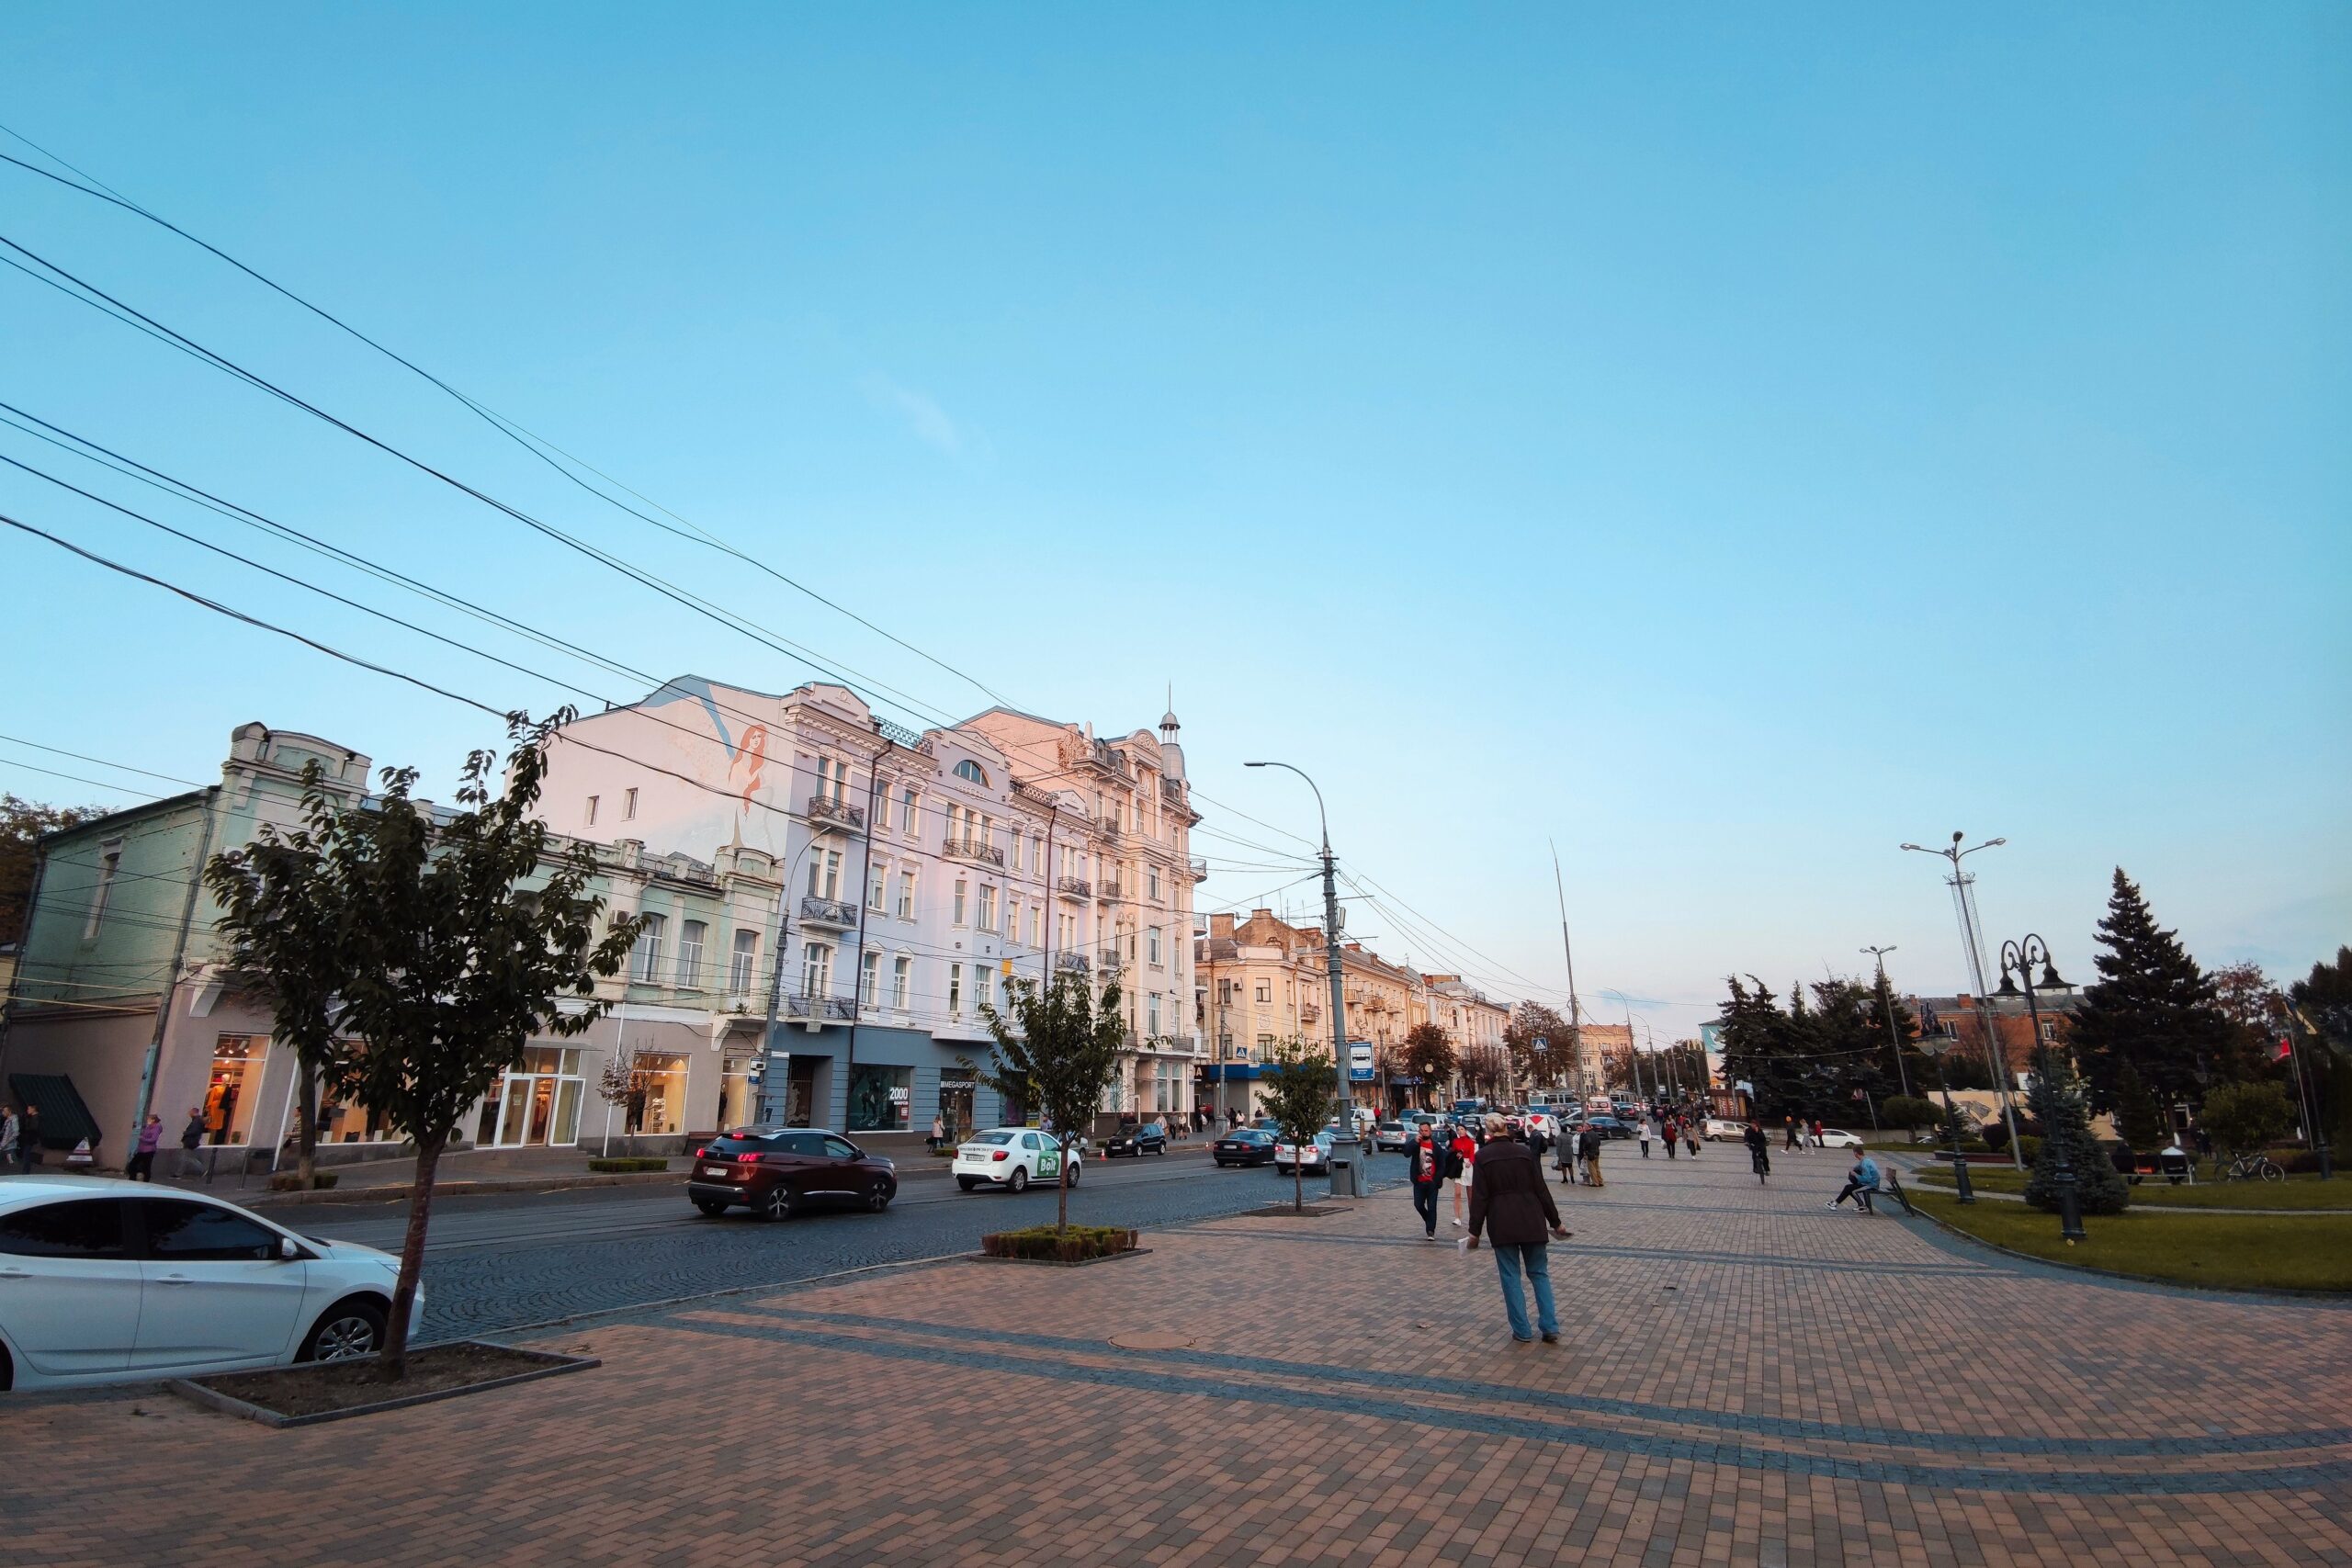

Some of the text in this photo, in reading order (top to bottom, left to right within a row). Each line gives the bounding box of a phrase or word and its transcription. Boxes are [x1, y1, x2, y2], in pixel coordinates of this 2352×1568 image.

[944, 1080, 975, 1089] MEGASPORT
[889, 1088, 909, 1100] 2000
[1040, 1157, 1056, 1172] Bolt
